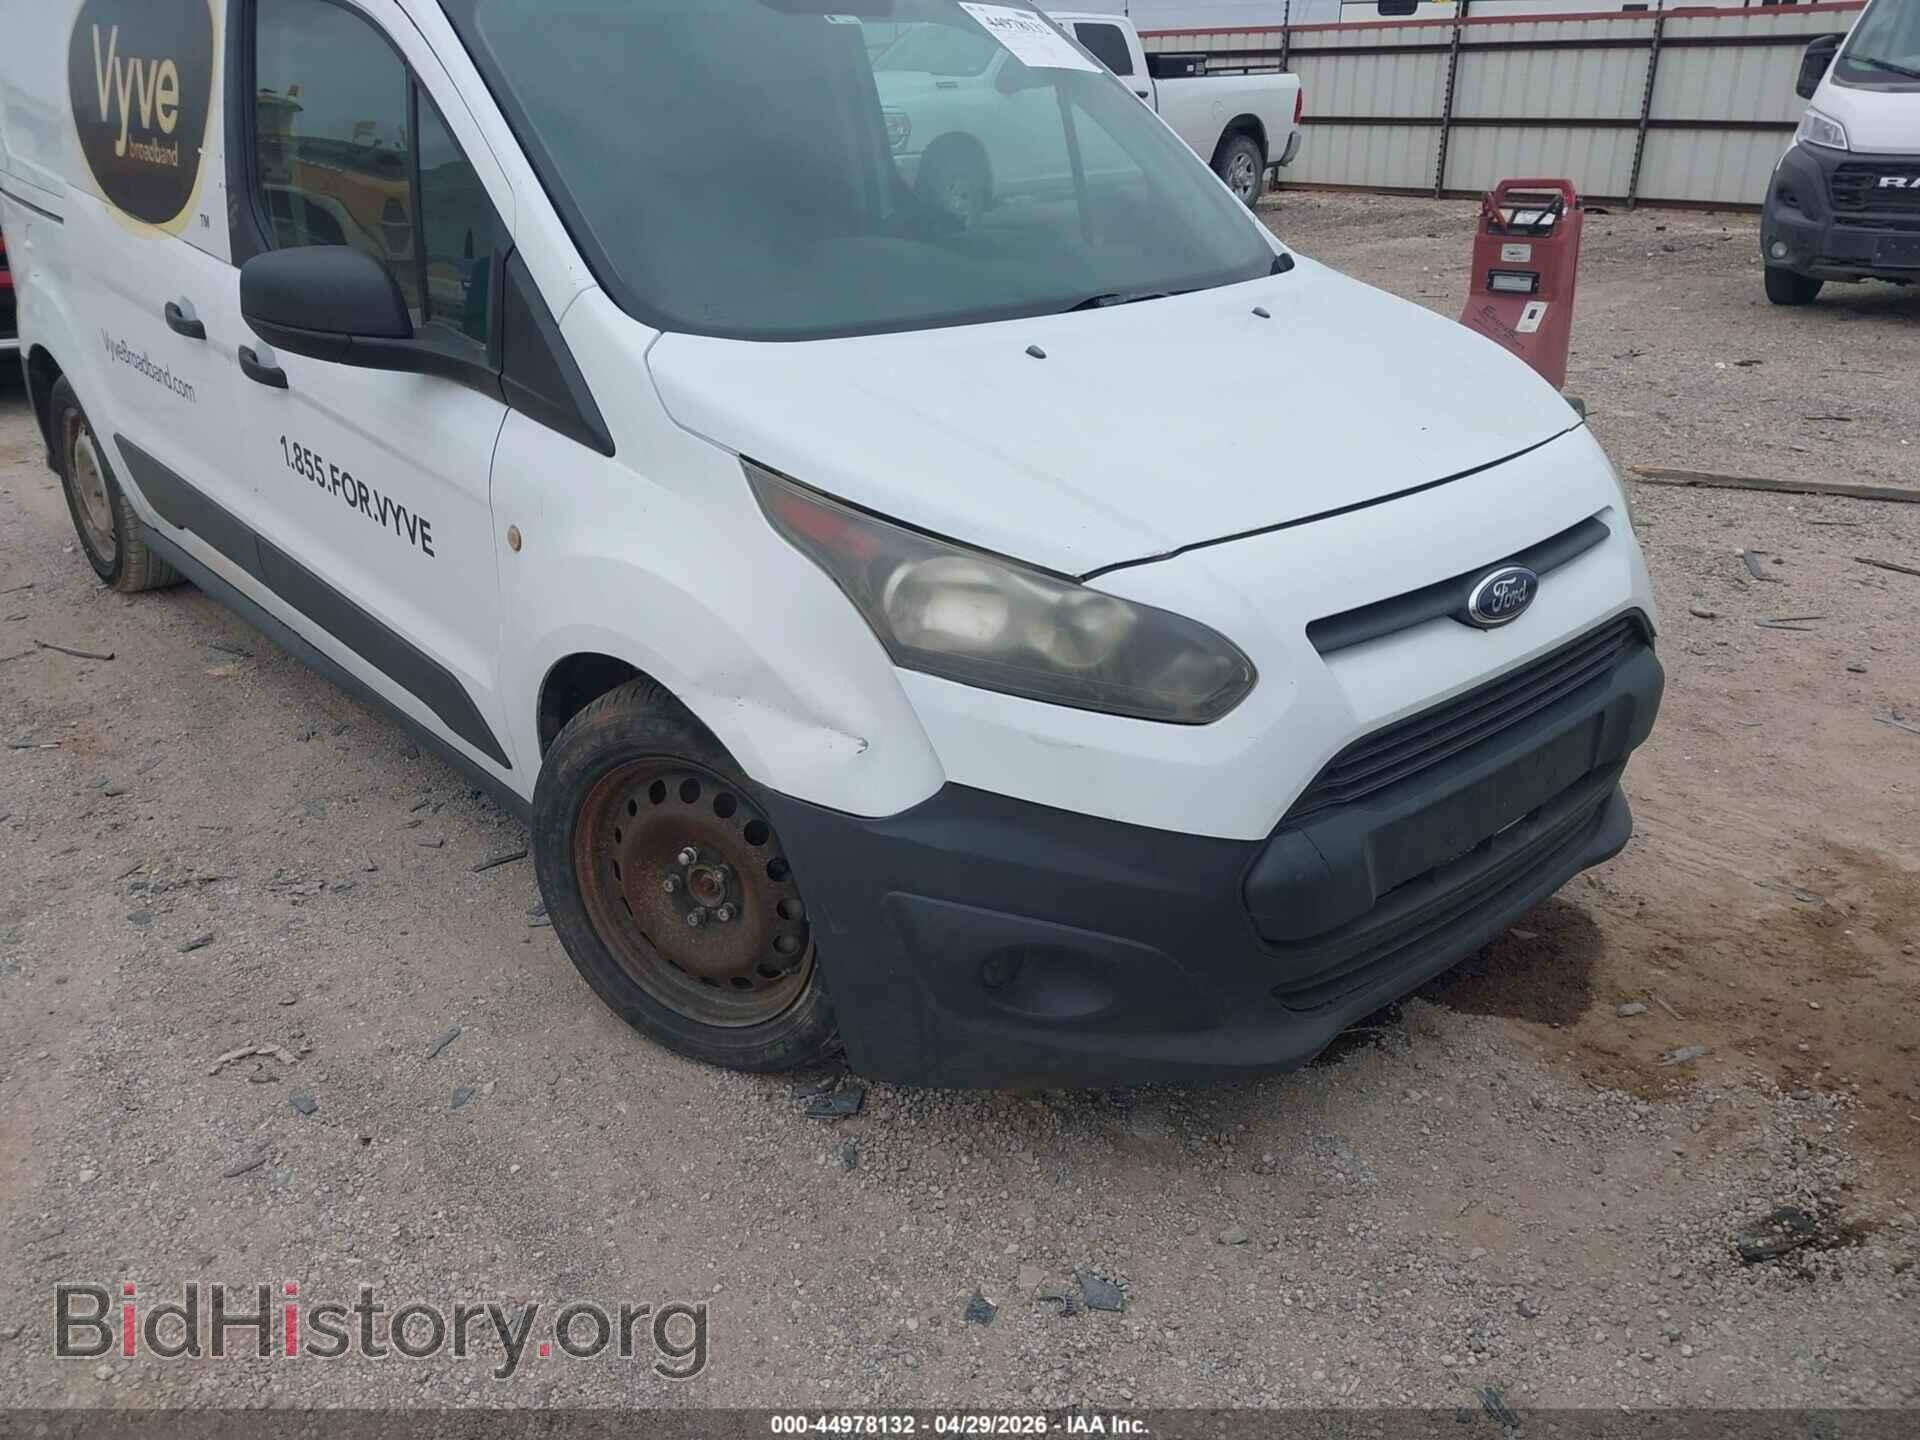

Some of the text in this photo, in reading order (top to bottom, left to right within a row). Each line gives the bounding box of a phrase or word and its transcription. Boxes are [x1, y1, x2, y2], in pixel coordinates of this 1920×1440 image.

[92, 24, 179, 157] Vyve
[127, 133, 178, 167] broadband
[200, 214, 210, 228] TM
[101, 327, 196, 403] VyveBroadband.com
[280, 435, 435, 558] 1.855.FOR.VYVE
[1491, 577, 1528, 613] Ford
